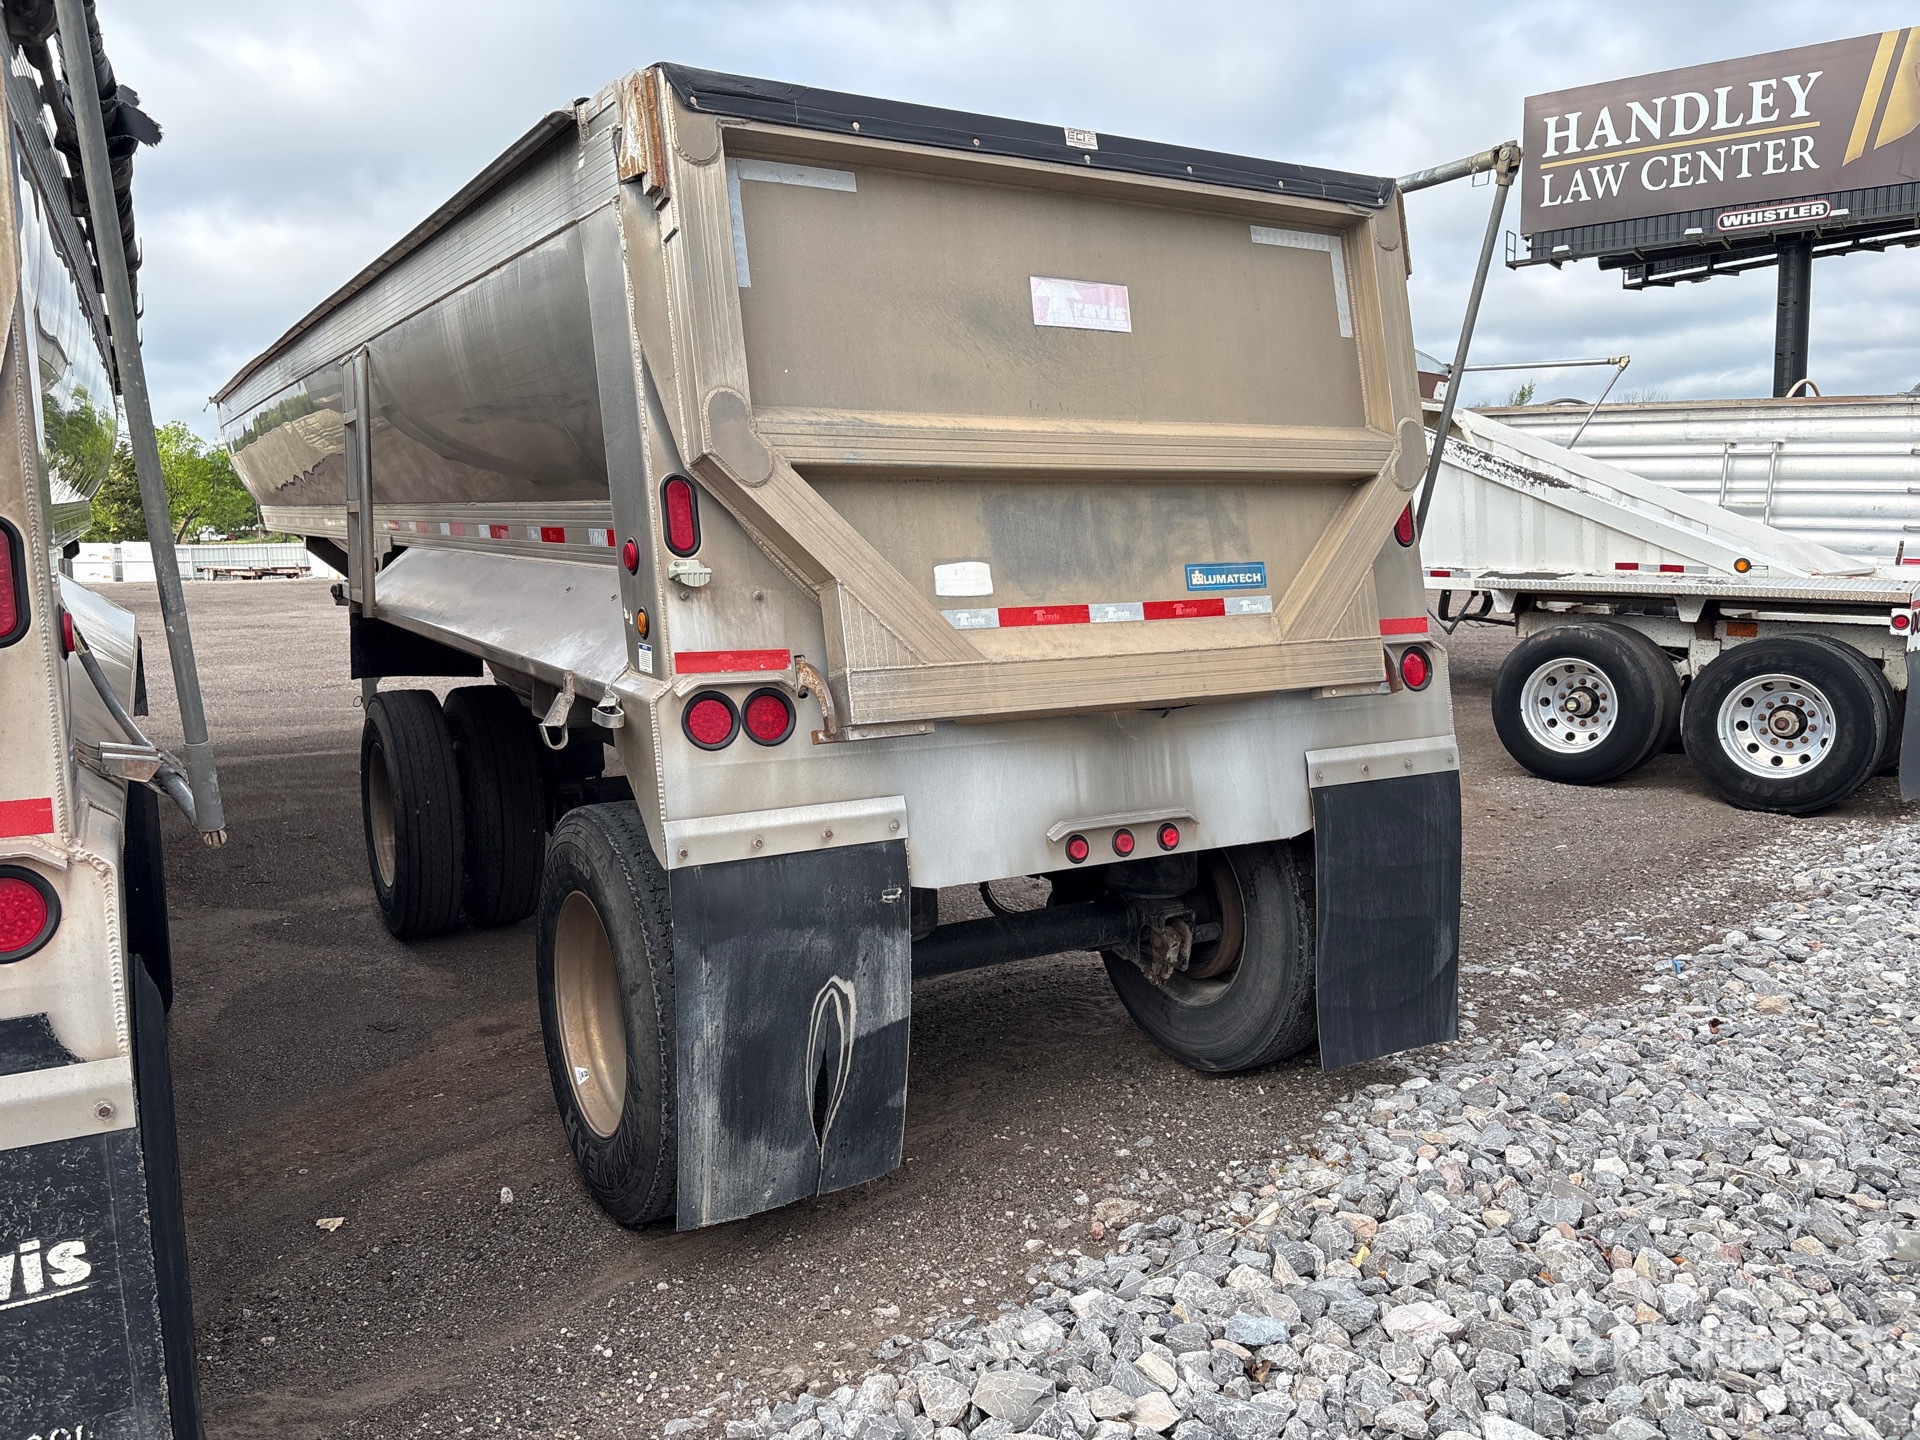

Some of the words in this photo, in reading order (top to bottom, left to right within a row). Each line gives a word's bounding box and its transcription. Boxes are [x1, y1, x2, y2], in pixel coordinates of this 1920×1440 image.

[1541, 70, 1824, 158] HANDLEY
[1539, 161, 1630, 208] LAW
[1640, 135, 1821, 192] CENTER
[1722, 202, 1825, 228] WHISTLER
